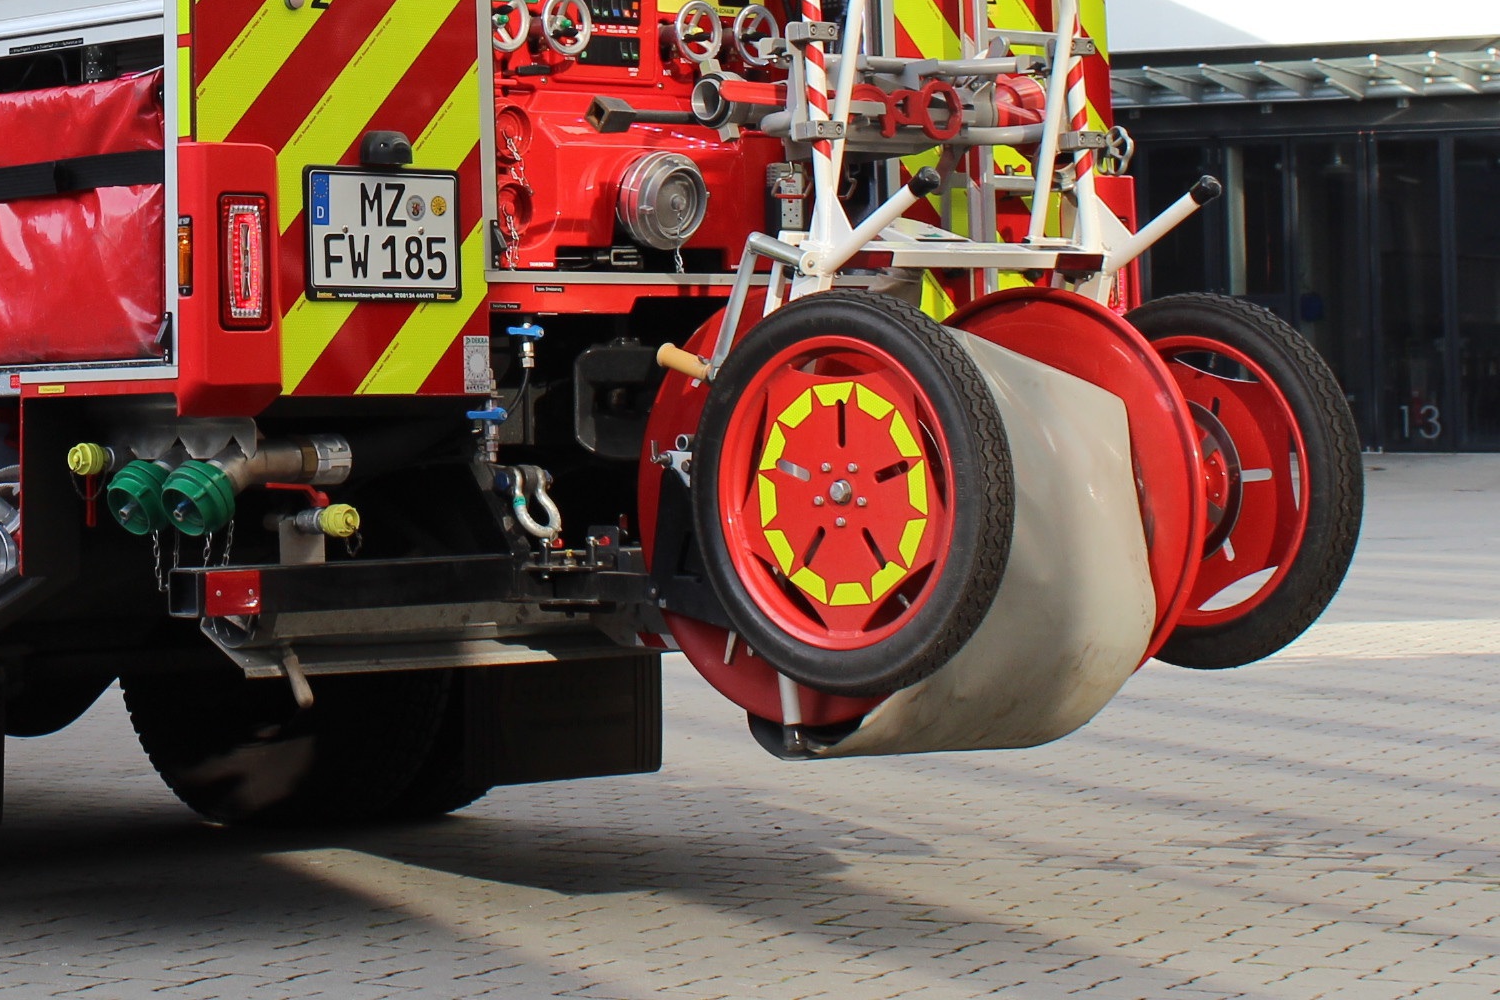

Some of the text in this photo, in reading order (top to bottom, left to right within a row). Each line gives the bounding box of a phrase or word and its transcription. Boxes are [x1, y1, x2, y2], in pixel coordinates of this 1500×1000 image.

[316, 205, 325, 219] D
[360, 182, 407, 227] MZ
[323, 233, 448, 281] FW 185
[1398, 405, 1442, 439] 13
